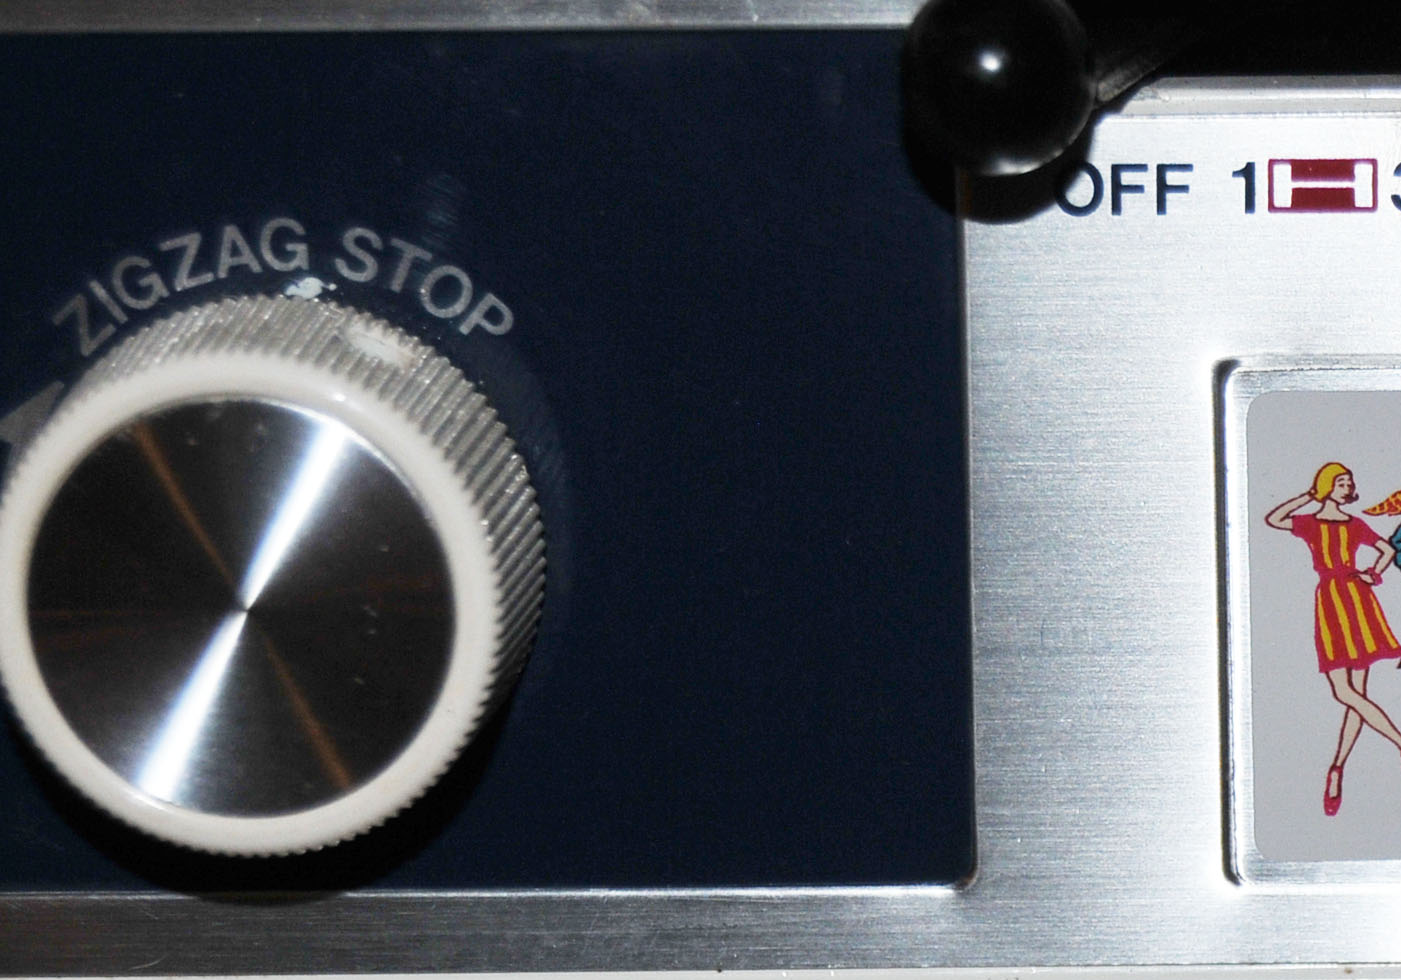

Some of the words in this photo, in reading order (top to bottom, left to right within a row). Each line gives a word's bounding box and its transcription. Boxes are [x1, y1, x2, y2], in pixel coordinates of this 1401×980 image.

[1055, 162, 1193, 216] OFF
[1231, 162, 1257, 214] 1
[53, 217, 310, 357] ZIGZAG
[334, 226, 515, 337] STOP
